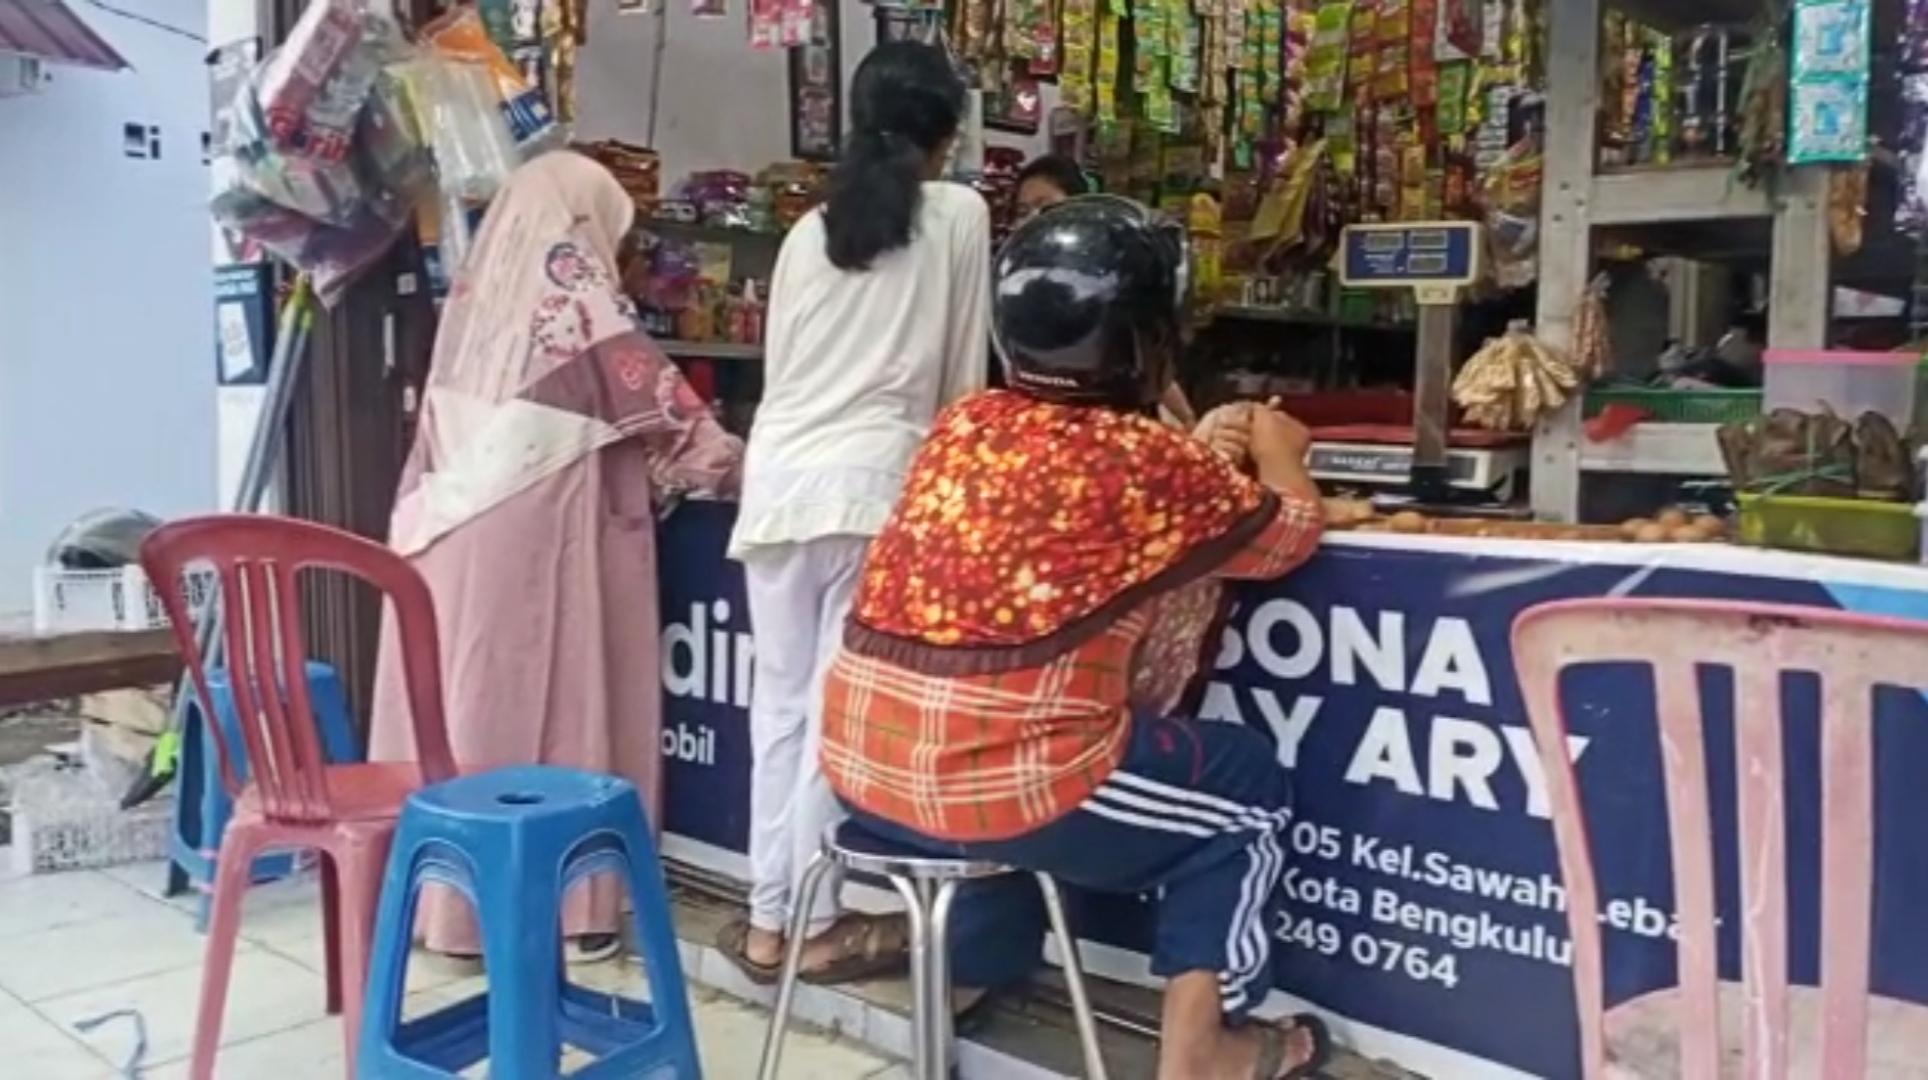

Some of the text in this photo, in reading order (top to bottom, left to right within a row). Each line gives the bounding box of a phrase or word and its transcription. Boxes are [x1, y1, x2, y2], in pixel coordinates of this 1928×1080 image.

[1343, 706, 1592, 820] ARY
[1292, 820, 1342, 860] 05
[1596, 896, 1723, 941] eba
[1371, 887, 1573, 967] Bengkulu
[1274, 909, 1459, 990] 249 0764
